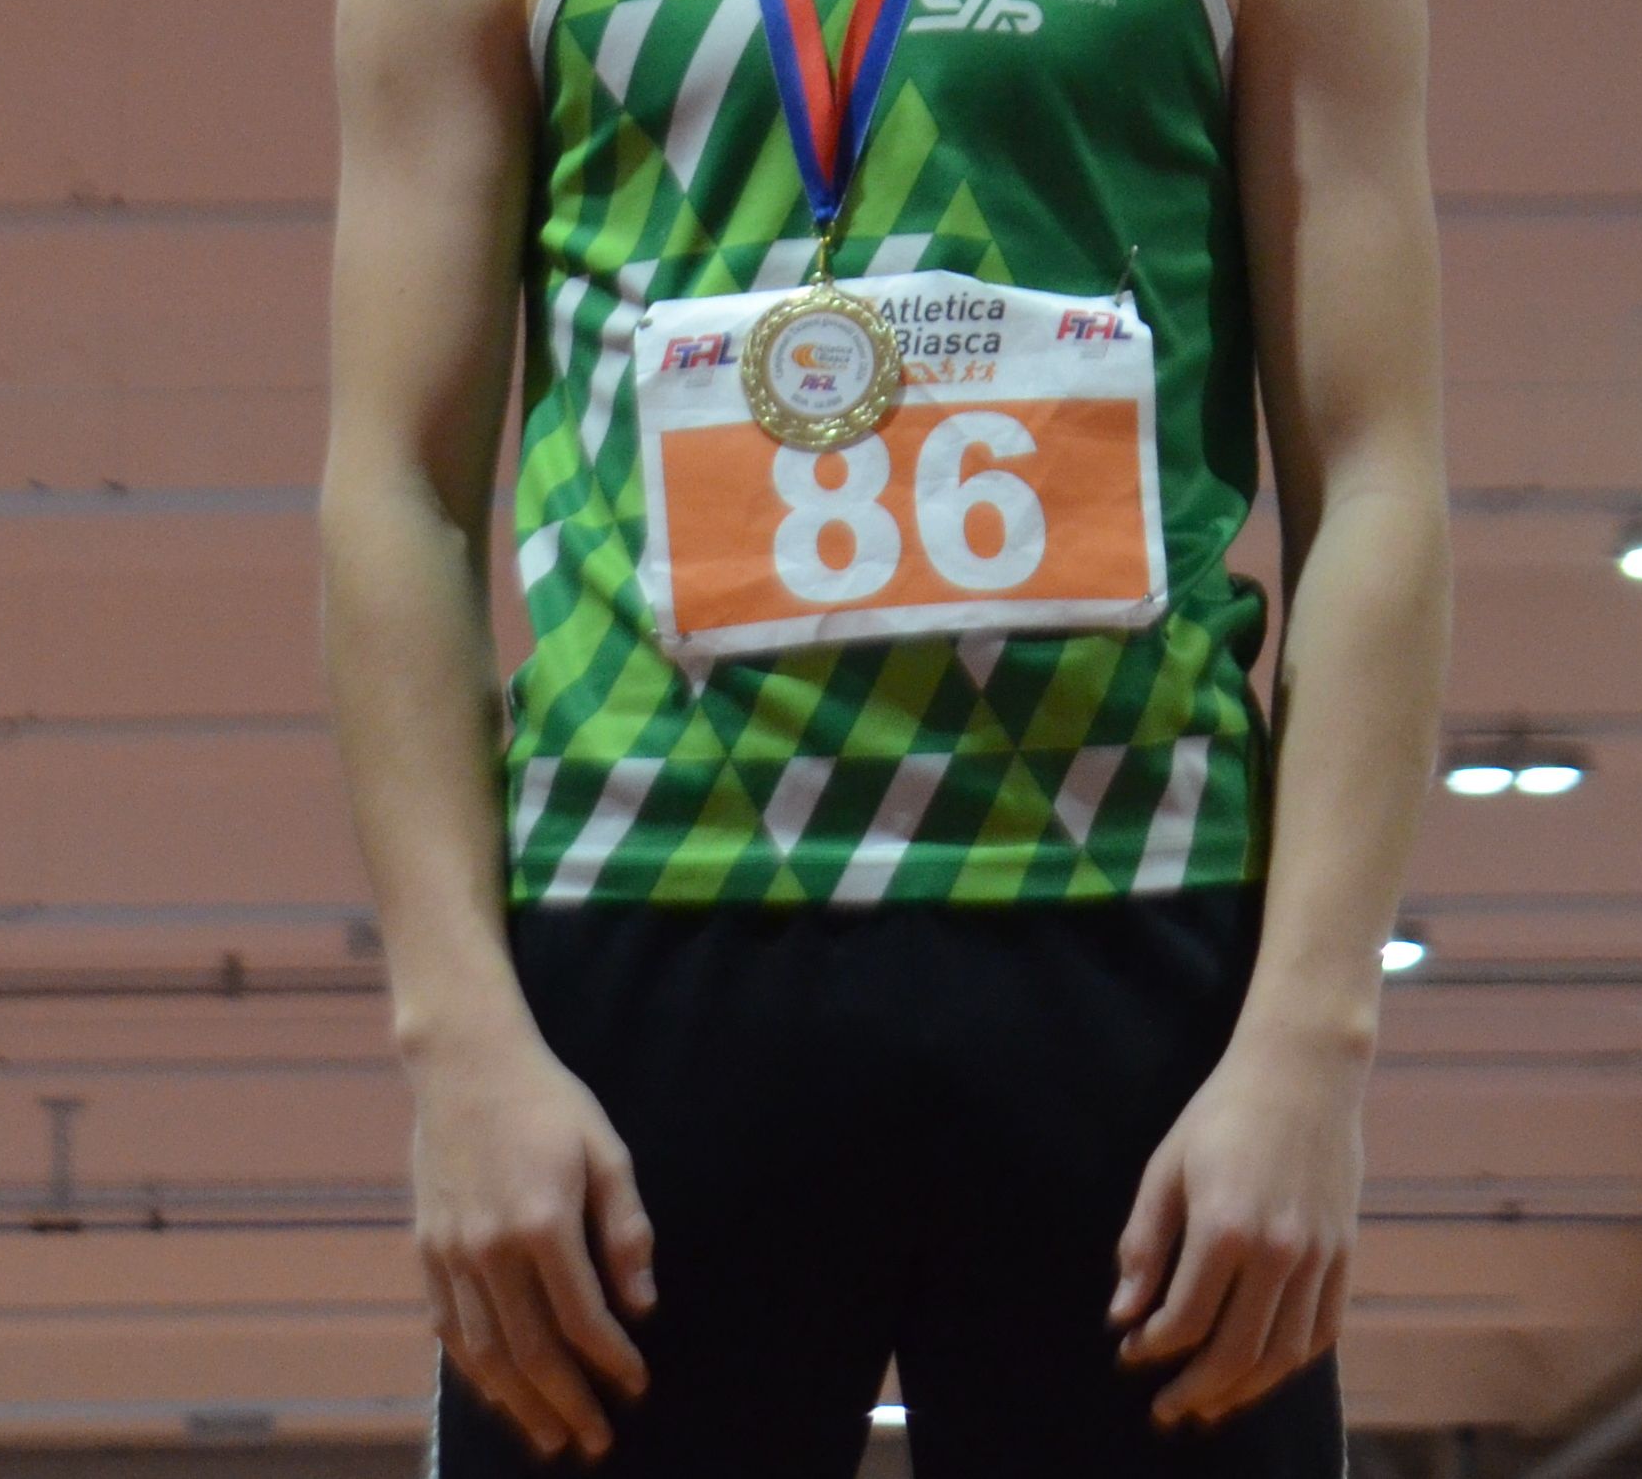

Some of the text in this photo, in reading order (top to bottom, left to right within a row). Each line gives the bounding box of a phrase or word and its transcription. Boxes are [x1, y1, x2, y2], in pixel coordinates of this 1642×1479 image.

[880, 291, 1006, 325] Atletica
[895, 326, 1002, 357] Biasca
[772, 410, 1047, 604] 86
